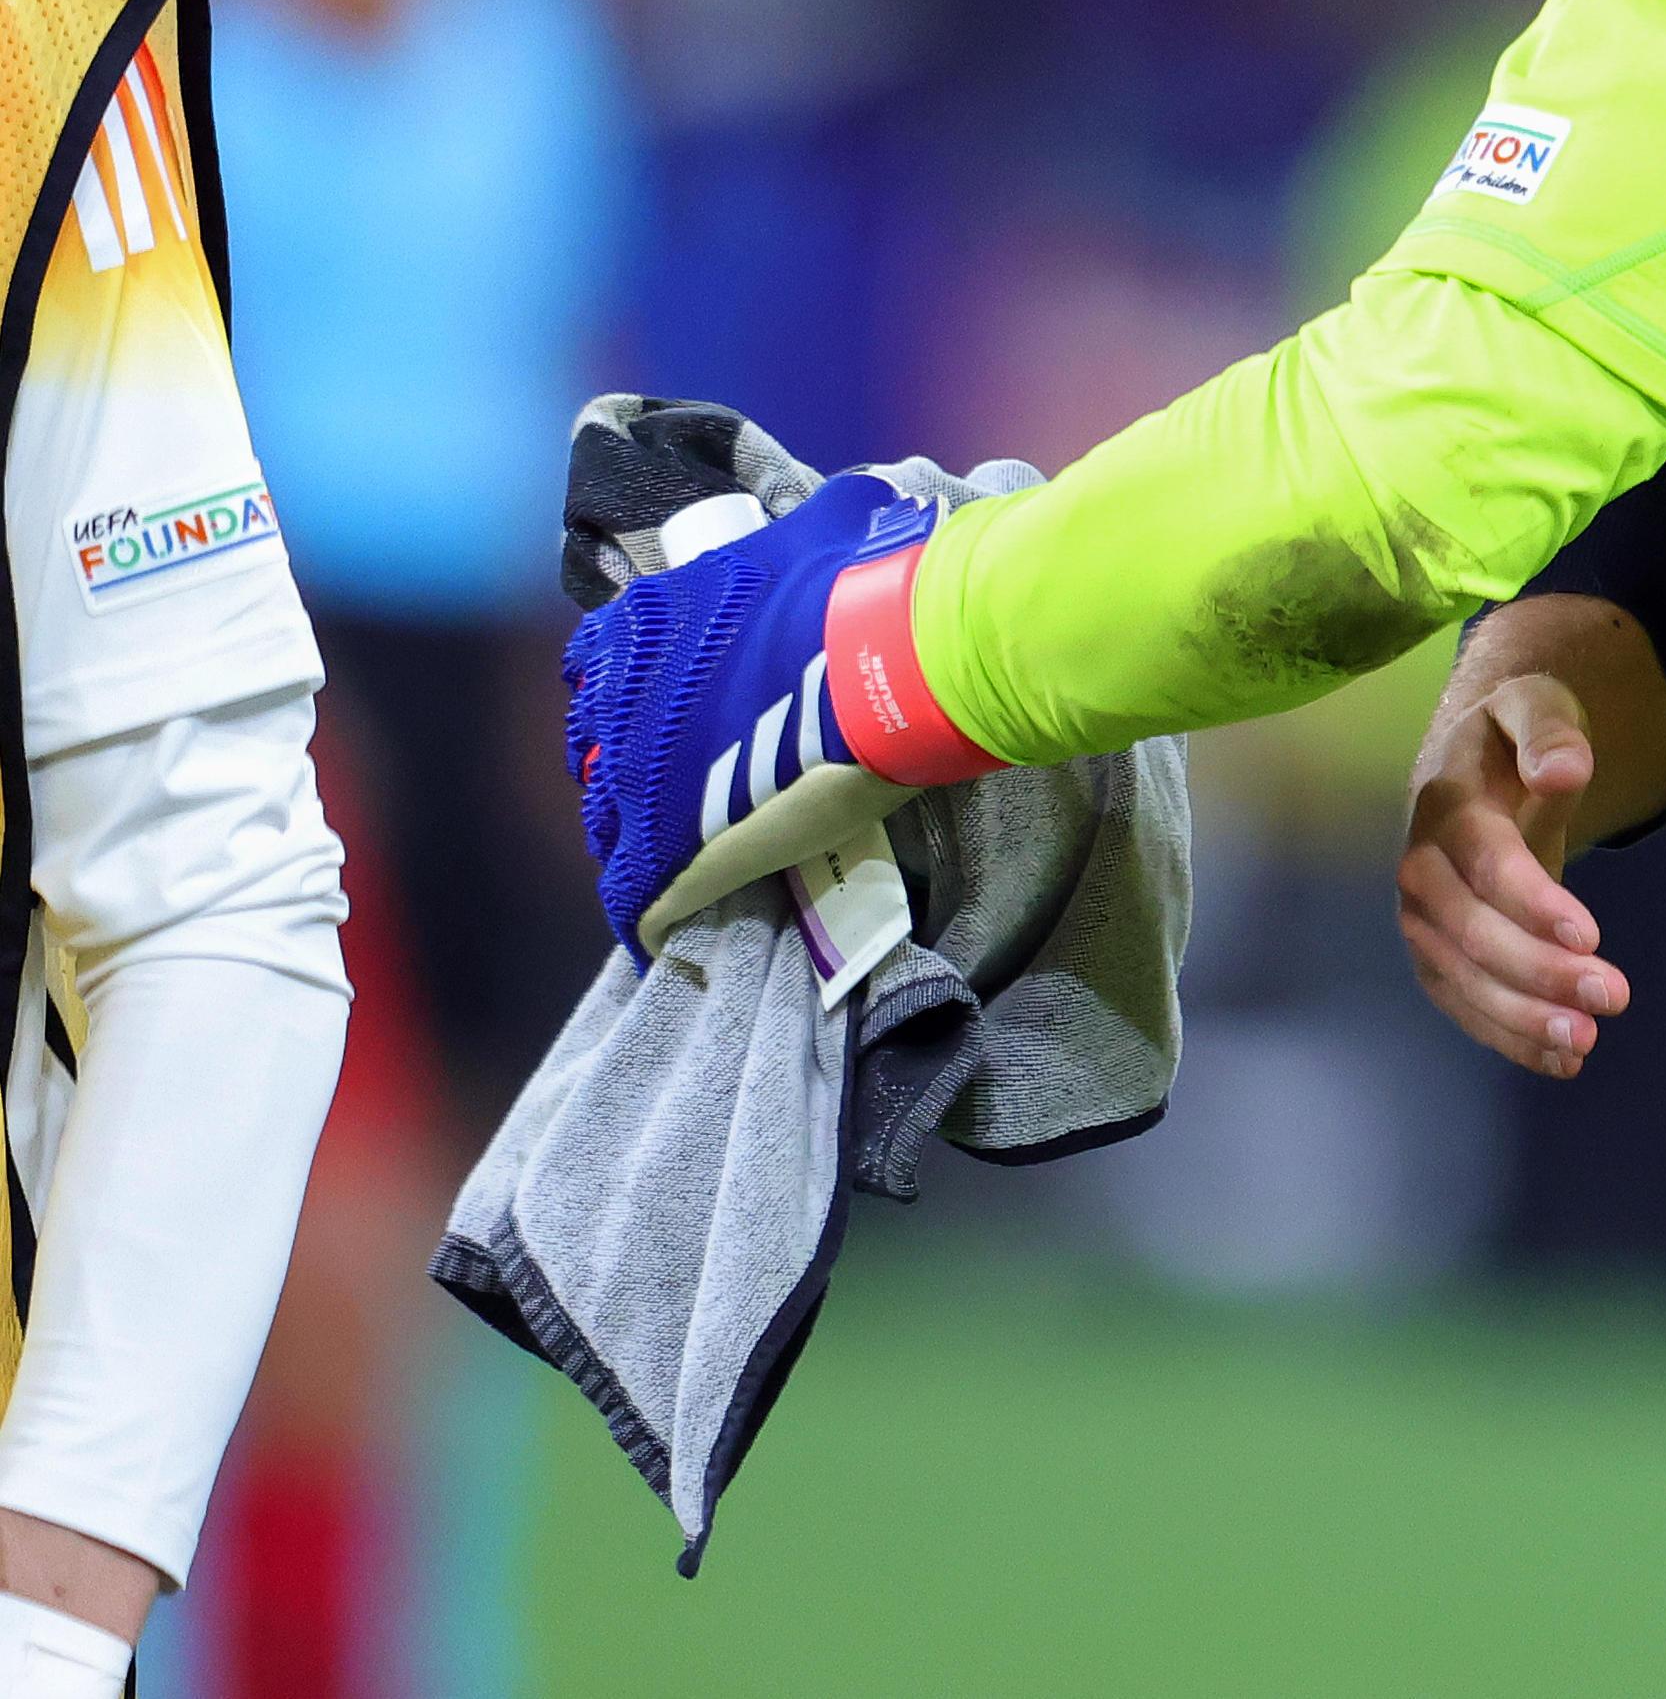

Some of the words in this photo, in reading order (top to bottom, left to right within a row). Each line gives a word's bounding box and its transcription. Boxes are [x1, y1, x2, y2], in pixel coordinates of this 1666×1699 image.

[1477, 170, 1529, 196] children
[73, 507, 139, 544] UEFA
[857, 644, 897, 735] MANUEL
[872, 653, 909, 730] NEUER
